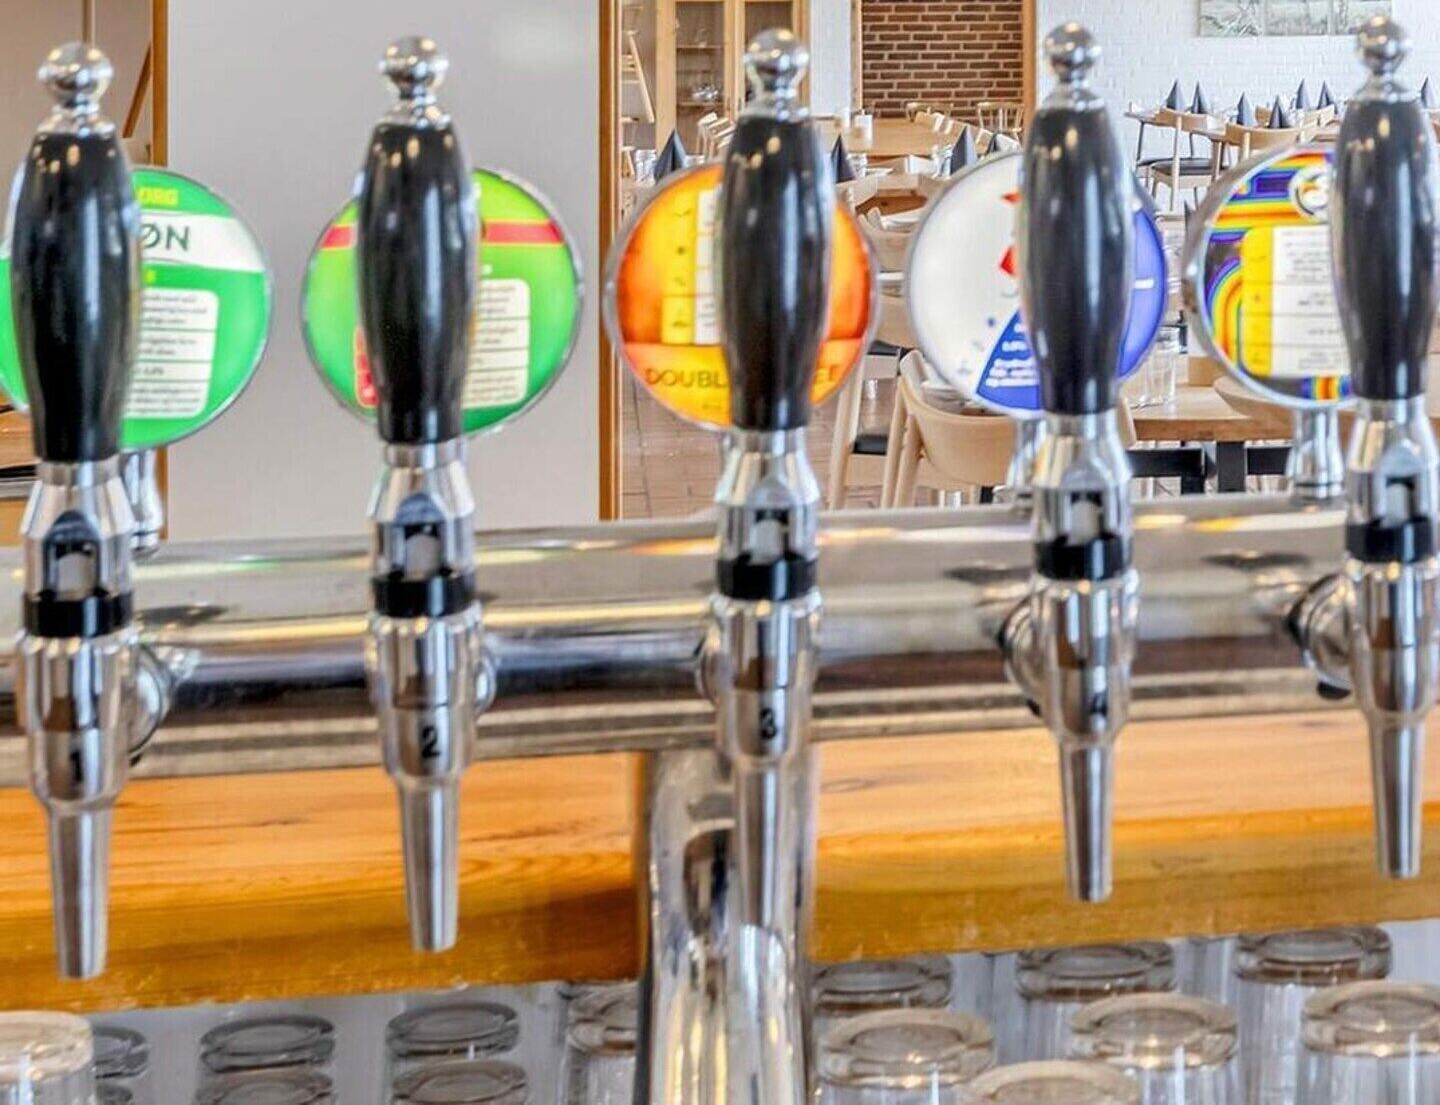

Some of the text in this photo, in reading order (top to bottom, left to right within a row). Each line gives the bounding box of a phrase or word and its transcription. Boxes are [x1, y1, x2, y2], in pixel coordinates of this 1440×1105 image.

[645, 368, 728, 388] DOUBL
[760, 707, 778, 740] 3
[421, 725, 441, 758] 2
